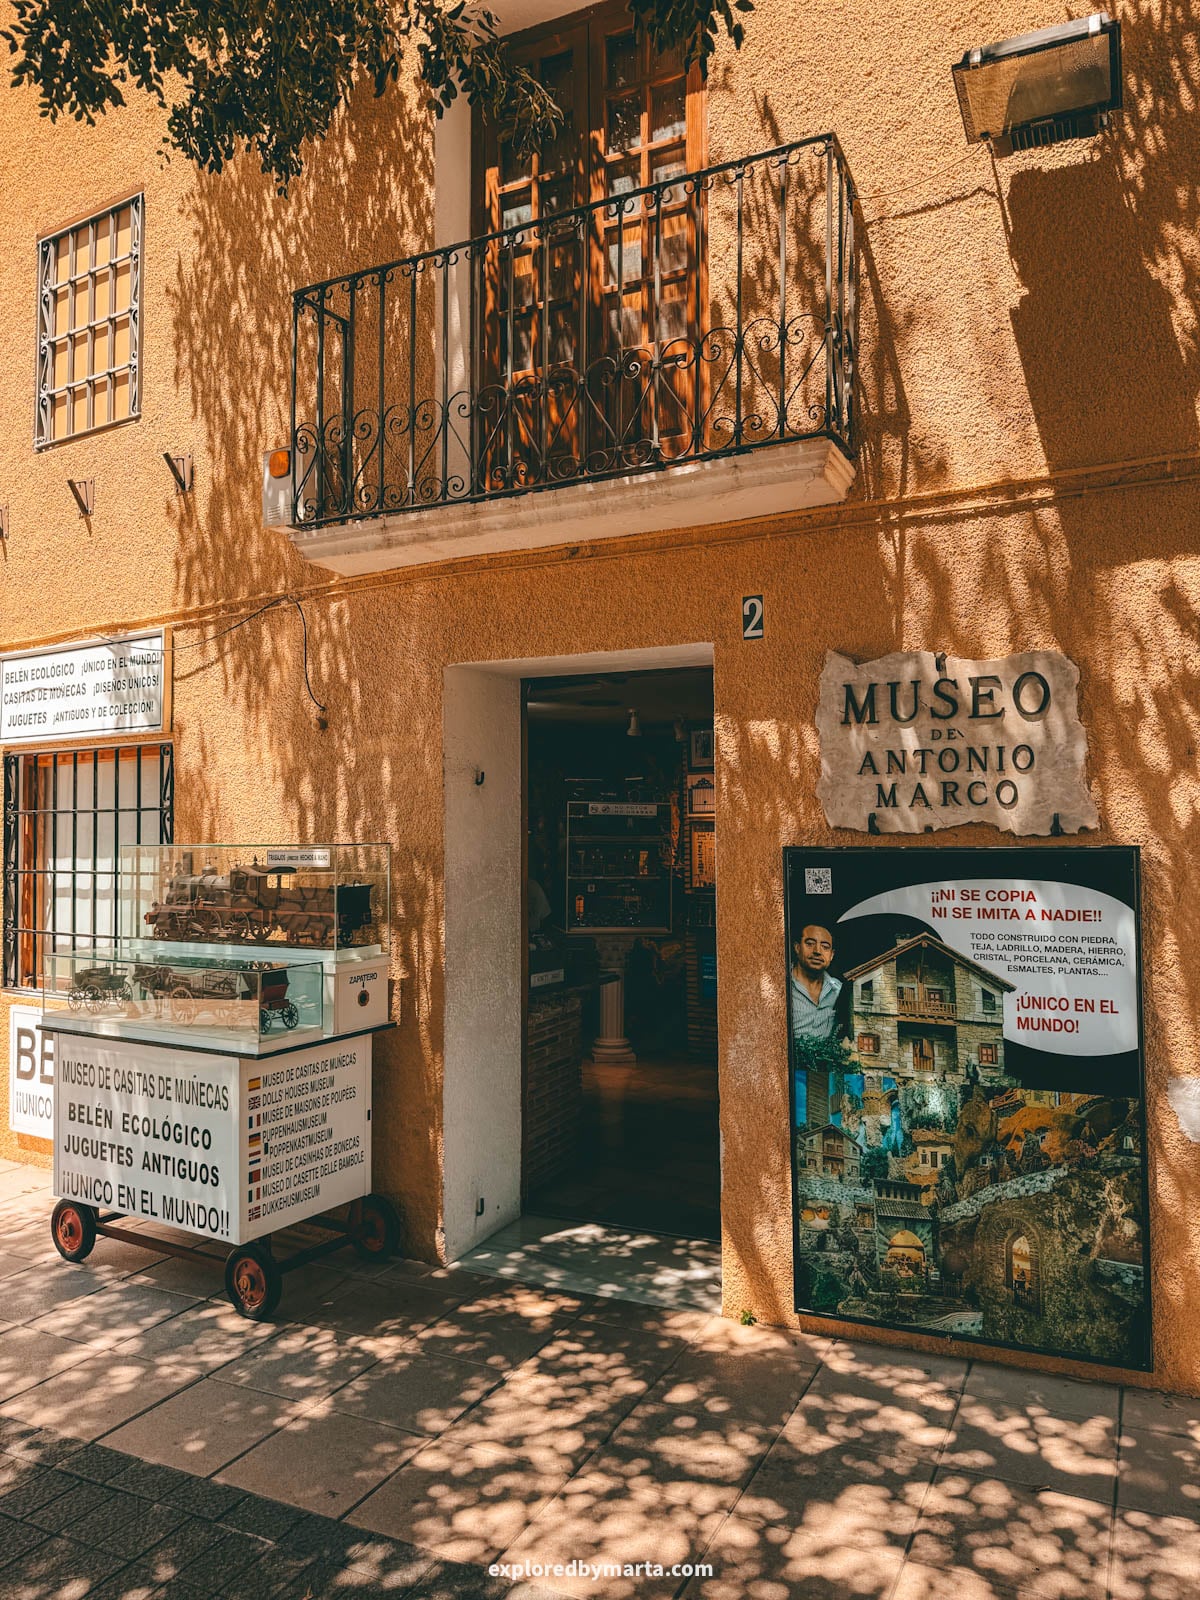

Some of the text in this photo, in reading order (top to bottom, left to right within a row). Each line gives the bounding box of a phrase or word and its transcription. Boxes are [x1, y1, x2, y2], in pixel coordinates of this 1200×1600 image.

[743, 598, 763, 637] 2
[5, 652, 160, 684] BELÉN ECOLÓGICO ¡ÚNICO EN EL MUNDO!
[3, 689, 36, 705] CASITAS
[38, 689, 48, 701] DE
[93, 678, 127, 697] ¡DISEÑOS
[128, 674, 159, 689] ÚNICOS!
[841, 671, 1050, 725] MUSEO
[7, 699, 154, 727] JUGUETES ¡ANTIGUOS Y DE COLECCIÓN!
[931, 729, 957, 741] DE
[858, 744, 1035, 775] ANTONIO
[876, 780, 1018, 808] MARCO
[931, 889, 1037, 903] ¡¡NI SE COPIA
[932, 907, 1102, 922] NI SE IMITA A NADIE!!
[970, 933, 1118, 945] TODO CONSTRUIDO CON PIEDRA,
[971, 943, 1127, 957] TEJA, LADRILLO, MADERA, HIERRO,
[973, 953, 1125, 967] CRISTAL, PORCELANA, CERÁMICA,
[1007, 965, 1056, 975] ESMALTES,
[349, 972, 378, 984] ZAPATERO
[1016, 992, 1119, 1014] ¡ÚNICO EN EL
[1017, 1016, 1080, 1033] MUNDO!
[62, 1060, 229, 1111] MUSEO DE CASITAS DE MUÑECAS
[262, 1052, 356, 1088] MUSEO DE CASITAS DE MUÑECAS
[285, 1082, 309, 1099] HOUSES
[310, 1075, 335, 1093] MUSEUM
[262, 1084, 356, 1125] MUSÉE DE MAISONS DE POUPÉES
[68, 1100, 212, 1150] BELÉN ECOLÓGICO
[262, 1112, 327, 1143] PUPPENHAUSMUSEUM
[262, 1135, 360, 1180] MUSEU DE CASINHAS DE BONECAS
[269, 1127, 333, 1159] POPPENKASTMUSEUM
[64, 1134, 219, 1187] JUGUETES ANTIGUOS
[262, 1150, 364, 1198] MUSEO DI CASETTE DELLE BAMBOLE
[62, 1171, 230, 1236] ¡¡UNICO EN EL MUNDO!!
[262, 1184, 320, 1216] DUKKEHUSMUSEUM
